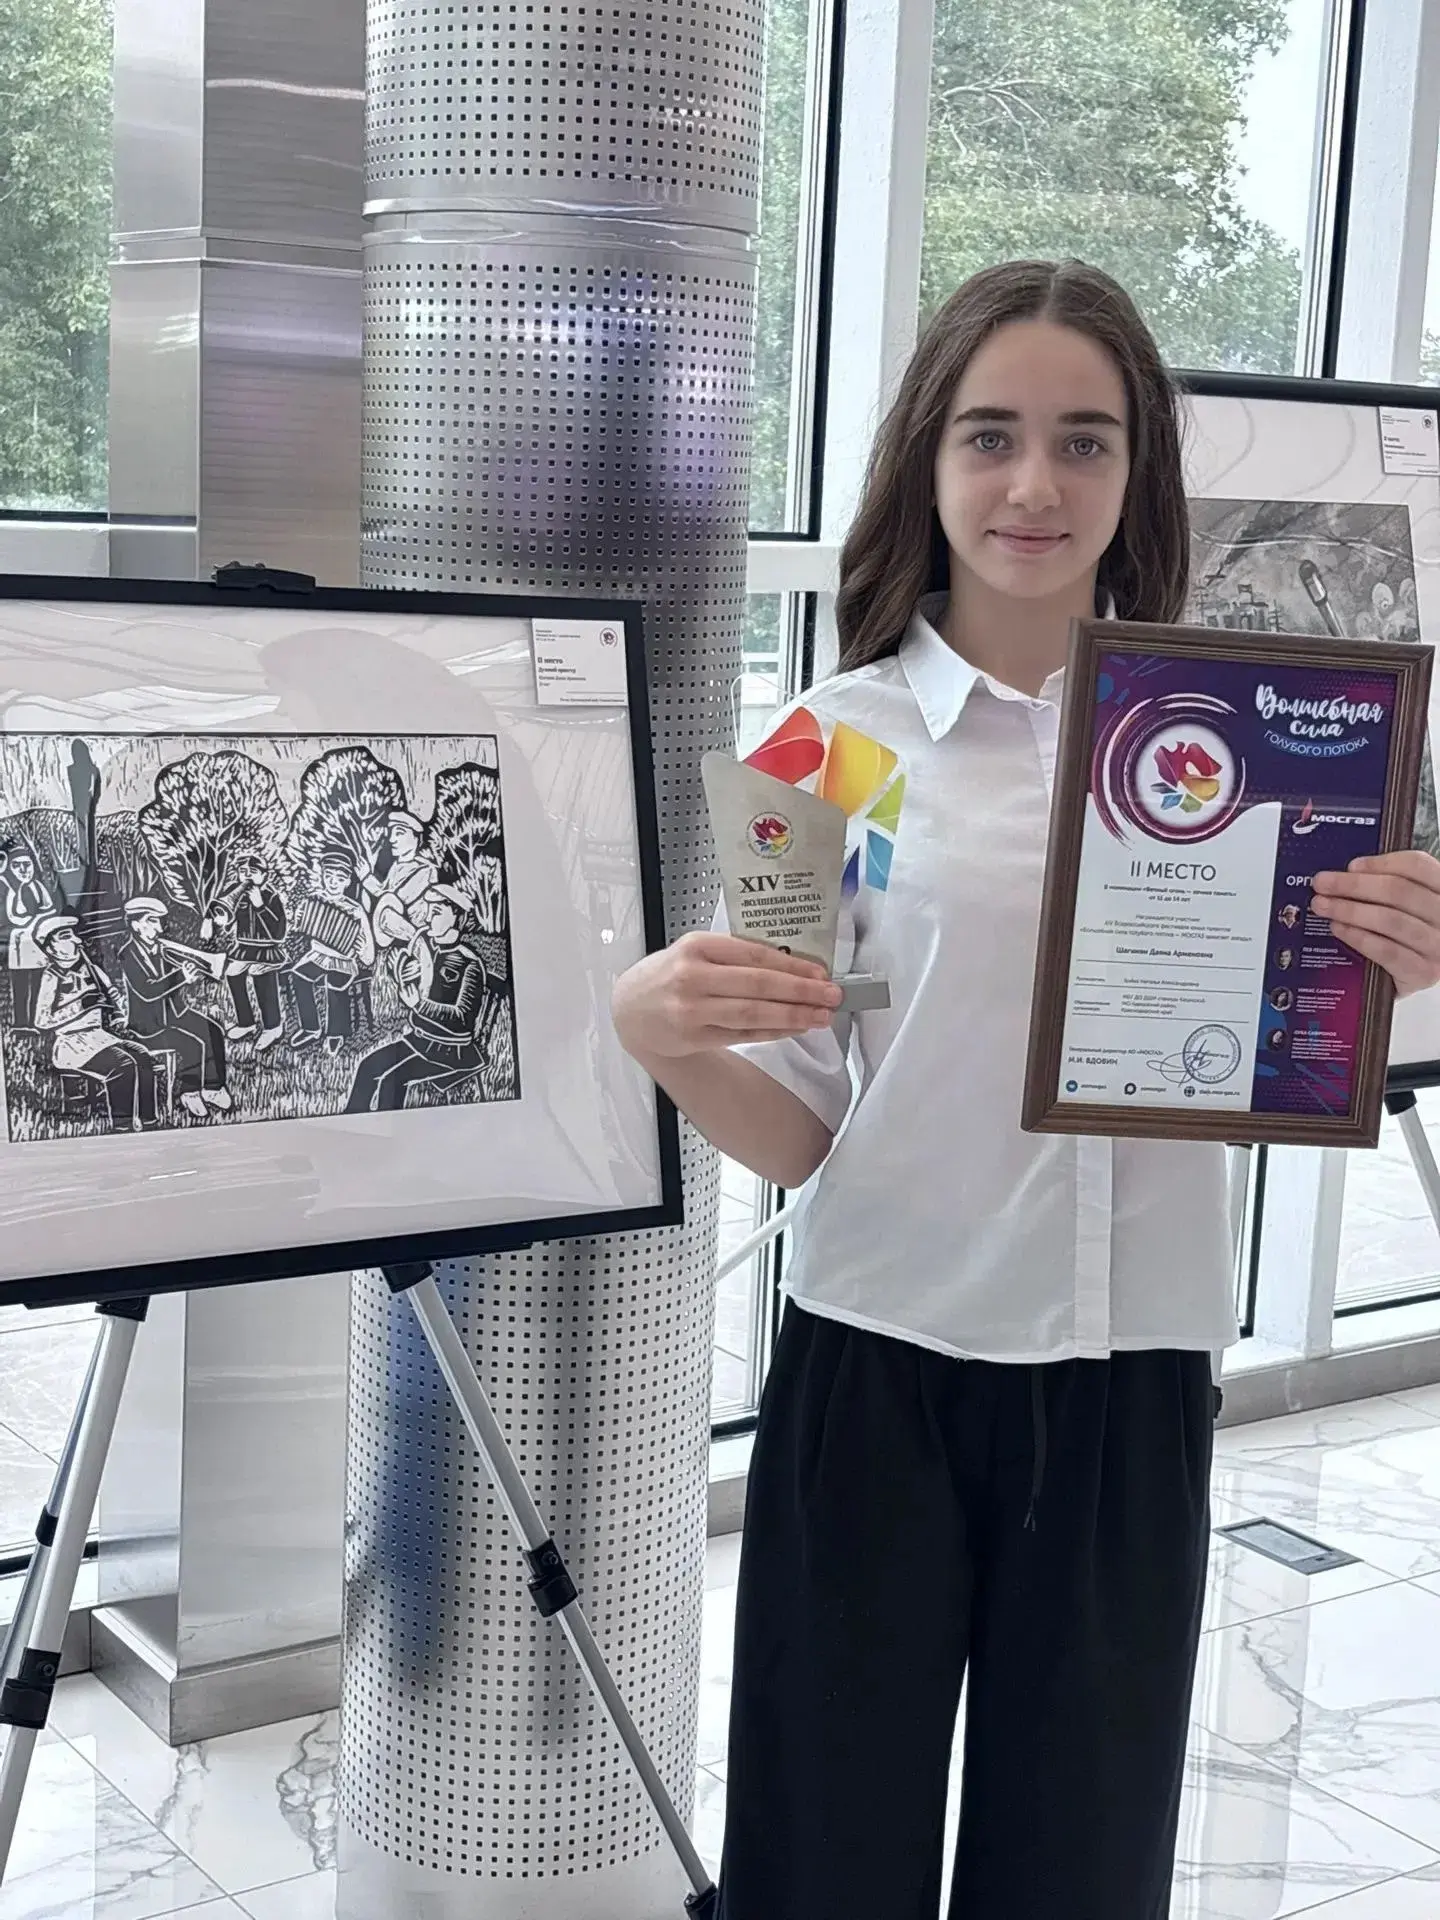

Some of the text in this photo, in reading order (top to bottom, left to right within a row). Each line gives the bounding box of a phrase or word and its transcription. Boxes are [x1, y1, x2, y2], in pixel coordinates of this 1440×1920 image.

[1256, 684, 1384, 725] Волшебная
[1264, 730, 1369, 756] ГОЛУБОГО ПОТОКА
[1130, 861, 1217, 881] II МЕСТО
[738, 874, 780, 893] XIV
[798, 893, 822, 901] СИЛА
[741, 907, 785, 918] ГОЛУБОГО
[786, 904, 821, 915] ПОТОКА
[745, 915, 821, 929] МОСГАЗ ЗАЖИГАЕТ
